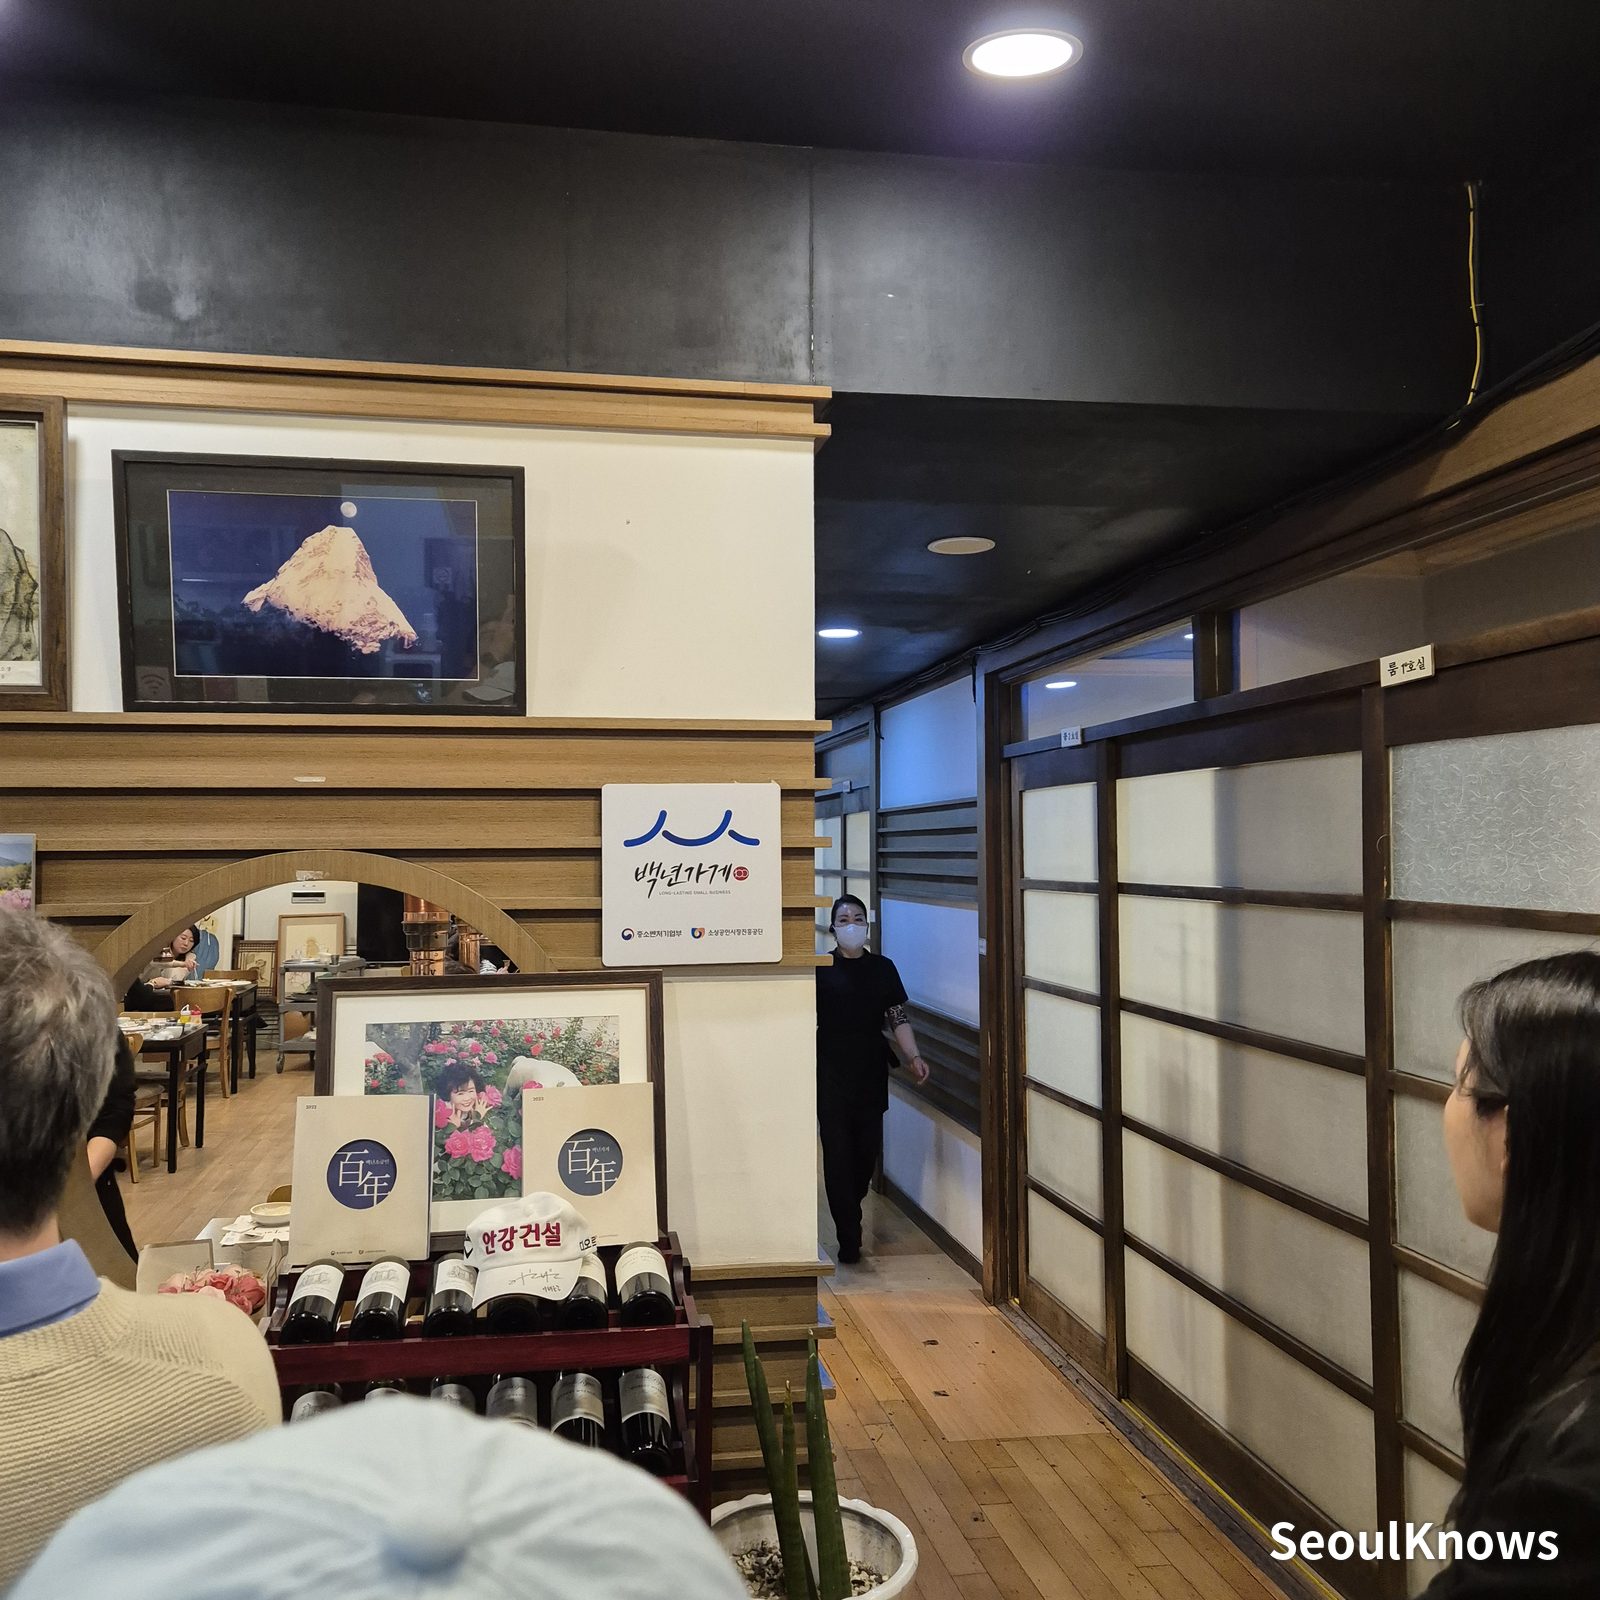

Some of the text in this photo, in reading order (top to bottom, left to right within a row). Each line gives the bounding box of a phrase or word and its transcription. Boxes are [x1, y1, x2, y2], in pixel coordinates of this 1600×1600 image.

[1387, 661, 1399, 677] 룸
[634, 861, 733, 899] 백년가게
[636, 930, 682, 939] 중소벤처기업부
[707, 928, 764, 937] 소상공인시장진흥공단
[482, 1222, 562, 1255] 안강건설
